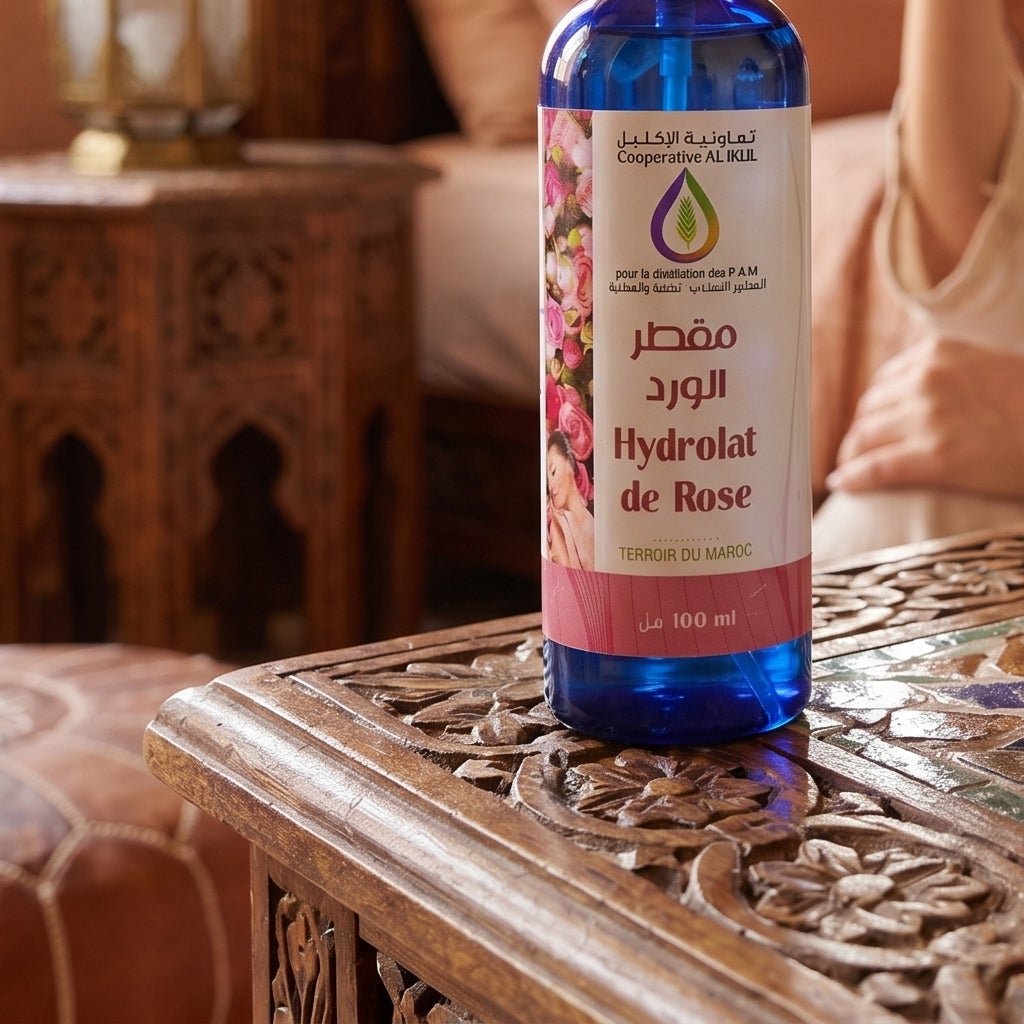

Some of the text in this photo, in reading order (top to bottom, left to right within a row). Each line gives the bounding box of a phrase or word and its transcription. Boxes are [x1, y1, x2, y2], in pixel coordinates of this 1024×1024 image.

[617, 150, 702, 167] Cooperative
[705, 150, 724, 163] AL
[616, 269, 638, 281] pour
[641, 268, 650, 279] la
[629, 318, 737, 361] مقطر
[646, 368, 726, 411] الورد
[614, 426, 758, 471] Hydrolat
[620, 480, 752, 513] de Rose
[619, 542, 753, 562] TERROIR DU MAROC
[673, 611, 707, 629] 100
[715, 609, 736, 626] ml
